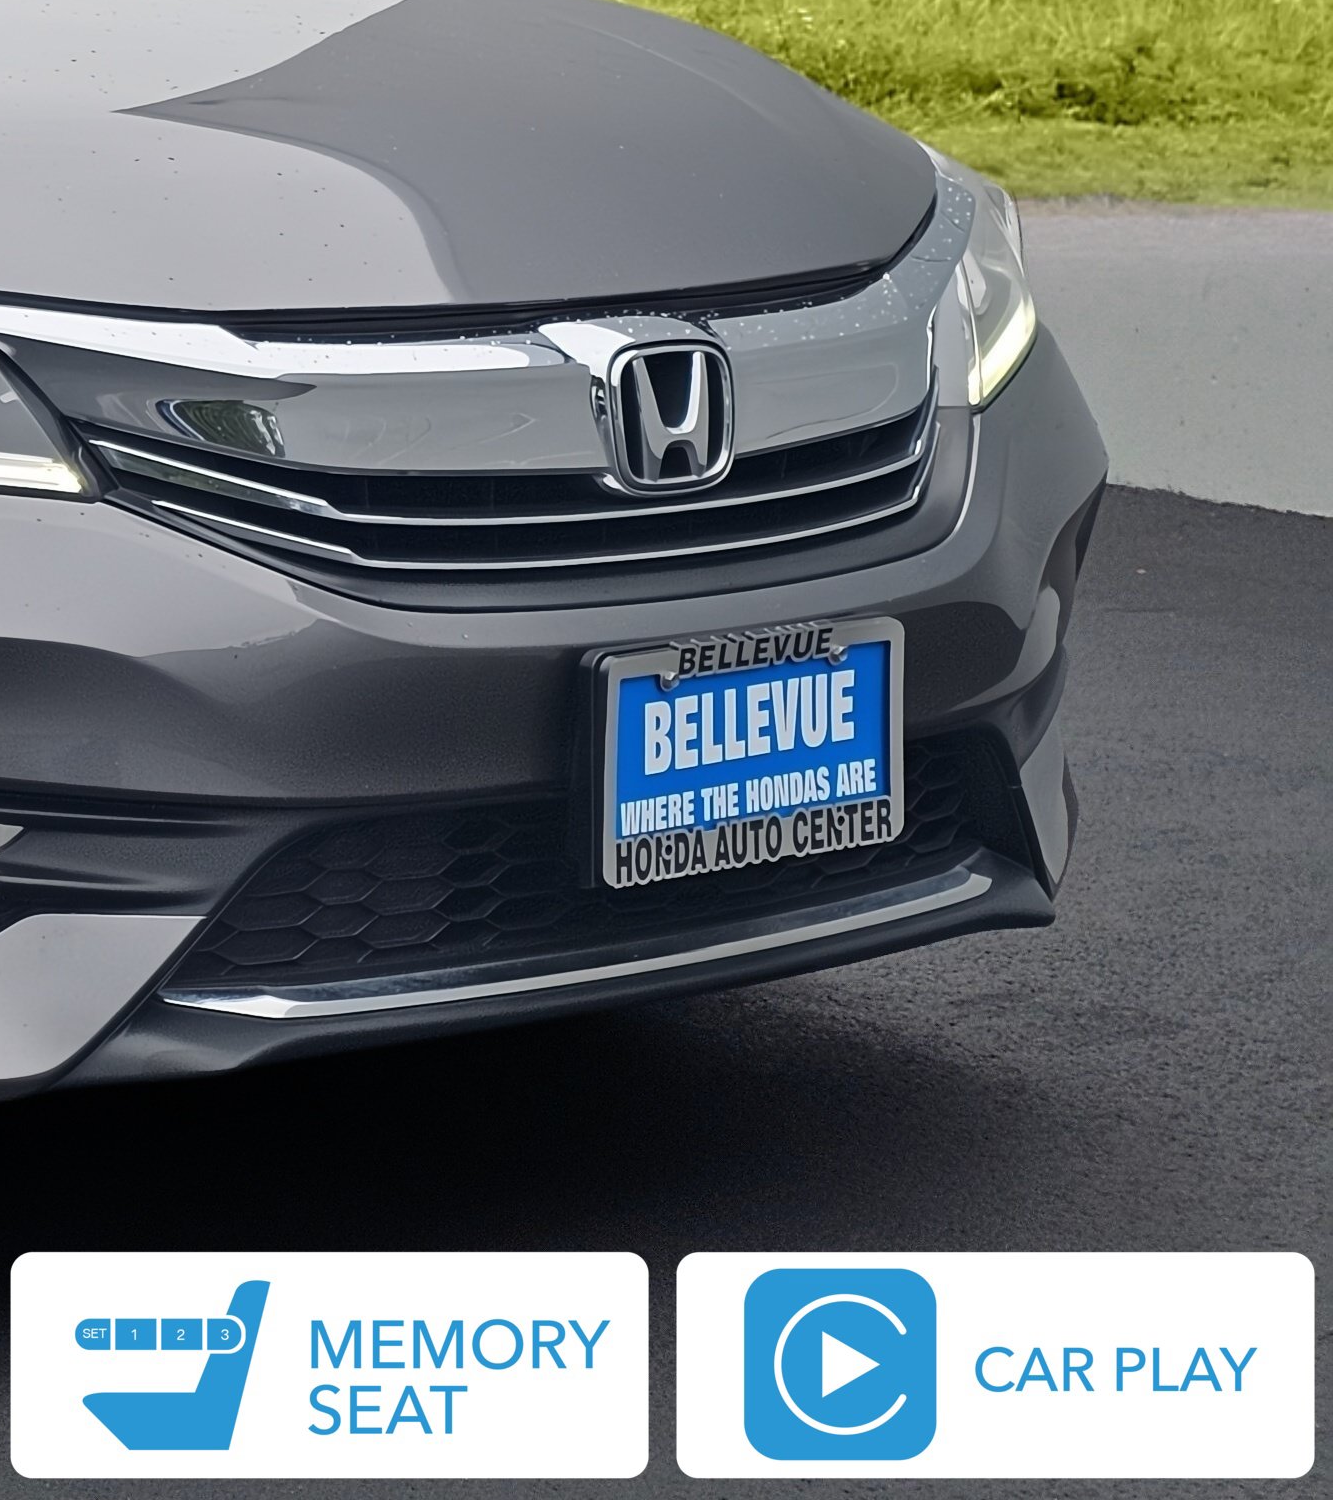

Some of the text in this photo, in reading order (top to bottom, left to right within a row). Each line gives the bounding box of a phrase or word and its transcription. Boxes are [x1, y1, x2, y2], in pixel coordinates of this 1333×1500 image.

[679, 627, 834, 676] BELLEVUE
[644, 669, 856, 776] BELLEVUE
[620, 758, 877, 837] WHERE THE HONDAS ARE
[615, 798, 892, 886] HONDA AUTO CENTER
